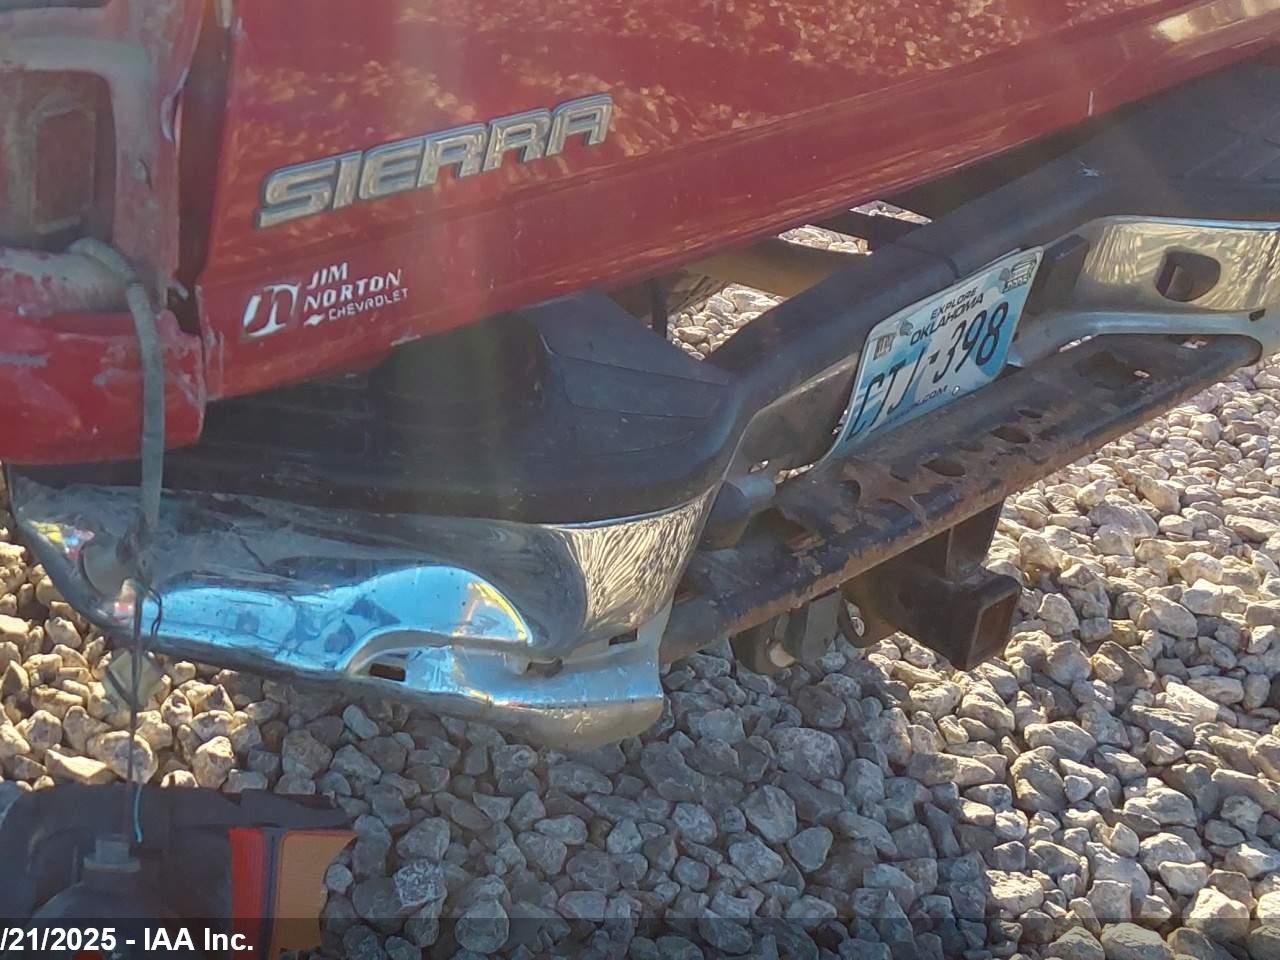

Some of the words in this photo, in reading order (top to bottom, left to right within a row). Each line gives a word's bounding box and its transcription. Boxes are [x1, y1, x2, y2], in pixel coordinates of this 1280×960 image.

[257, 93, 614, 231] SIERRA
[303, 268, 403, 313] NORTON
[306, 262, 349, 289] JIM
[328, 288, 410, 321] CHEVROLET
[910, 292, 985, 347] OKLAHOMA
[930, 286, 979, 321] EXPLORE
